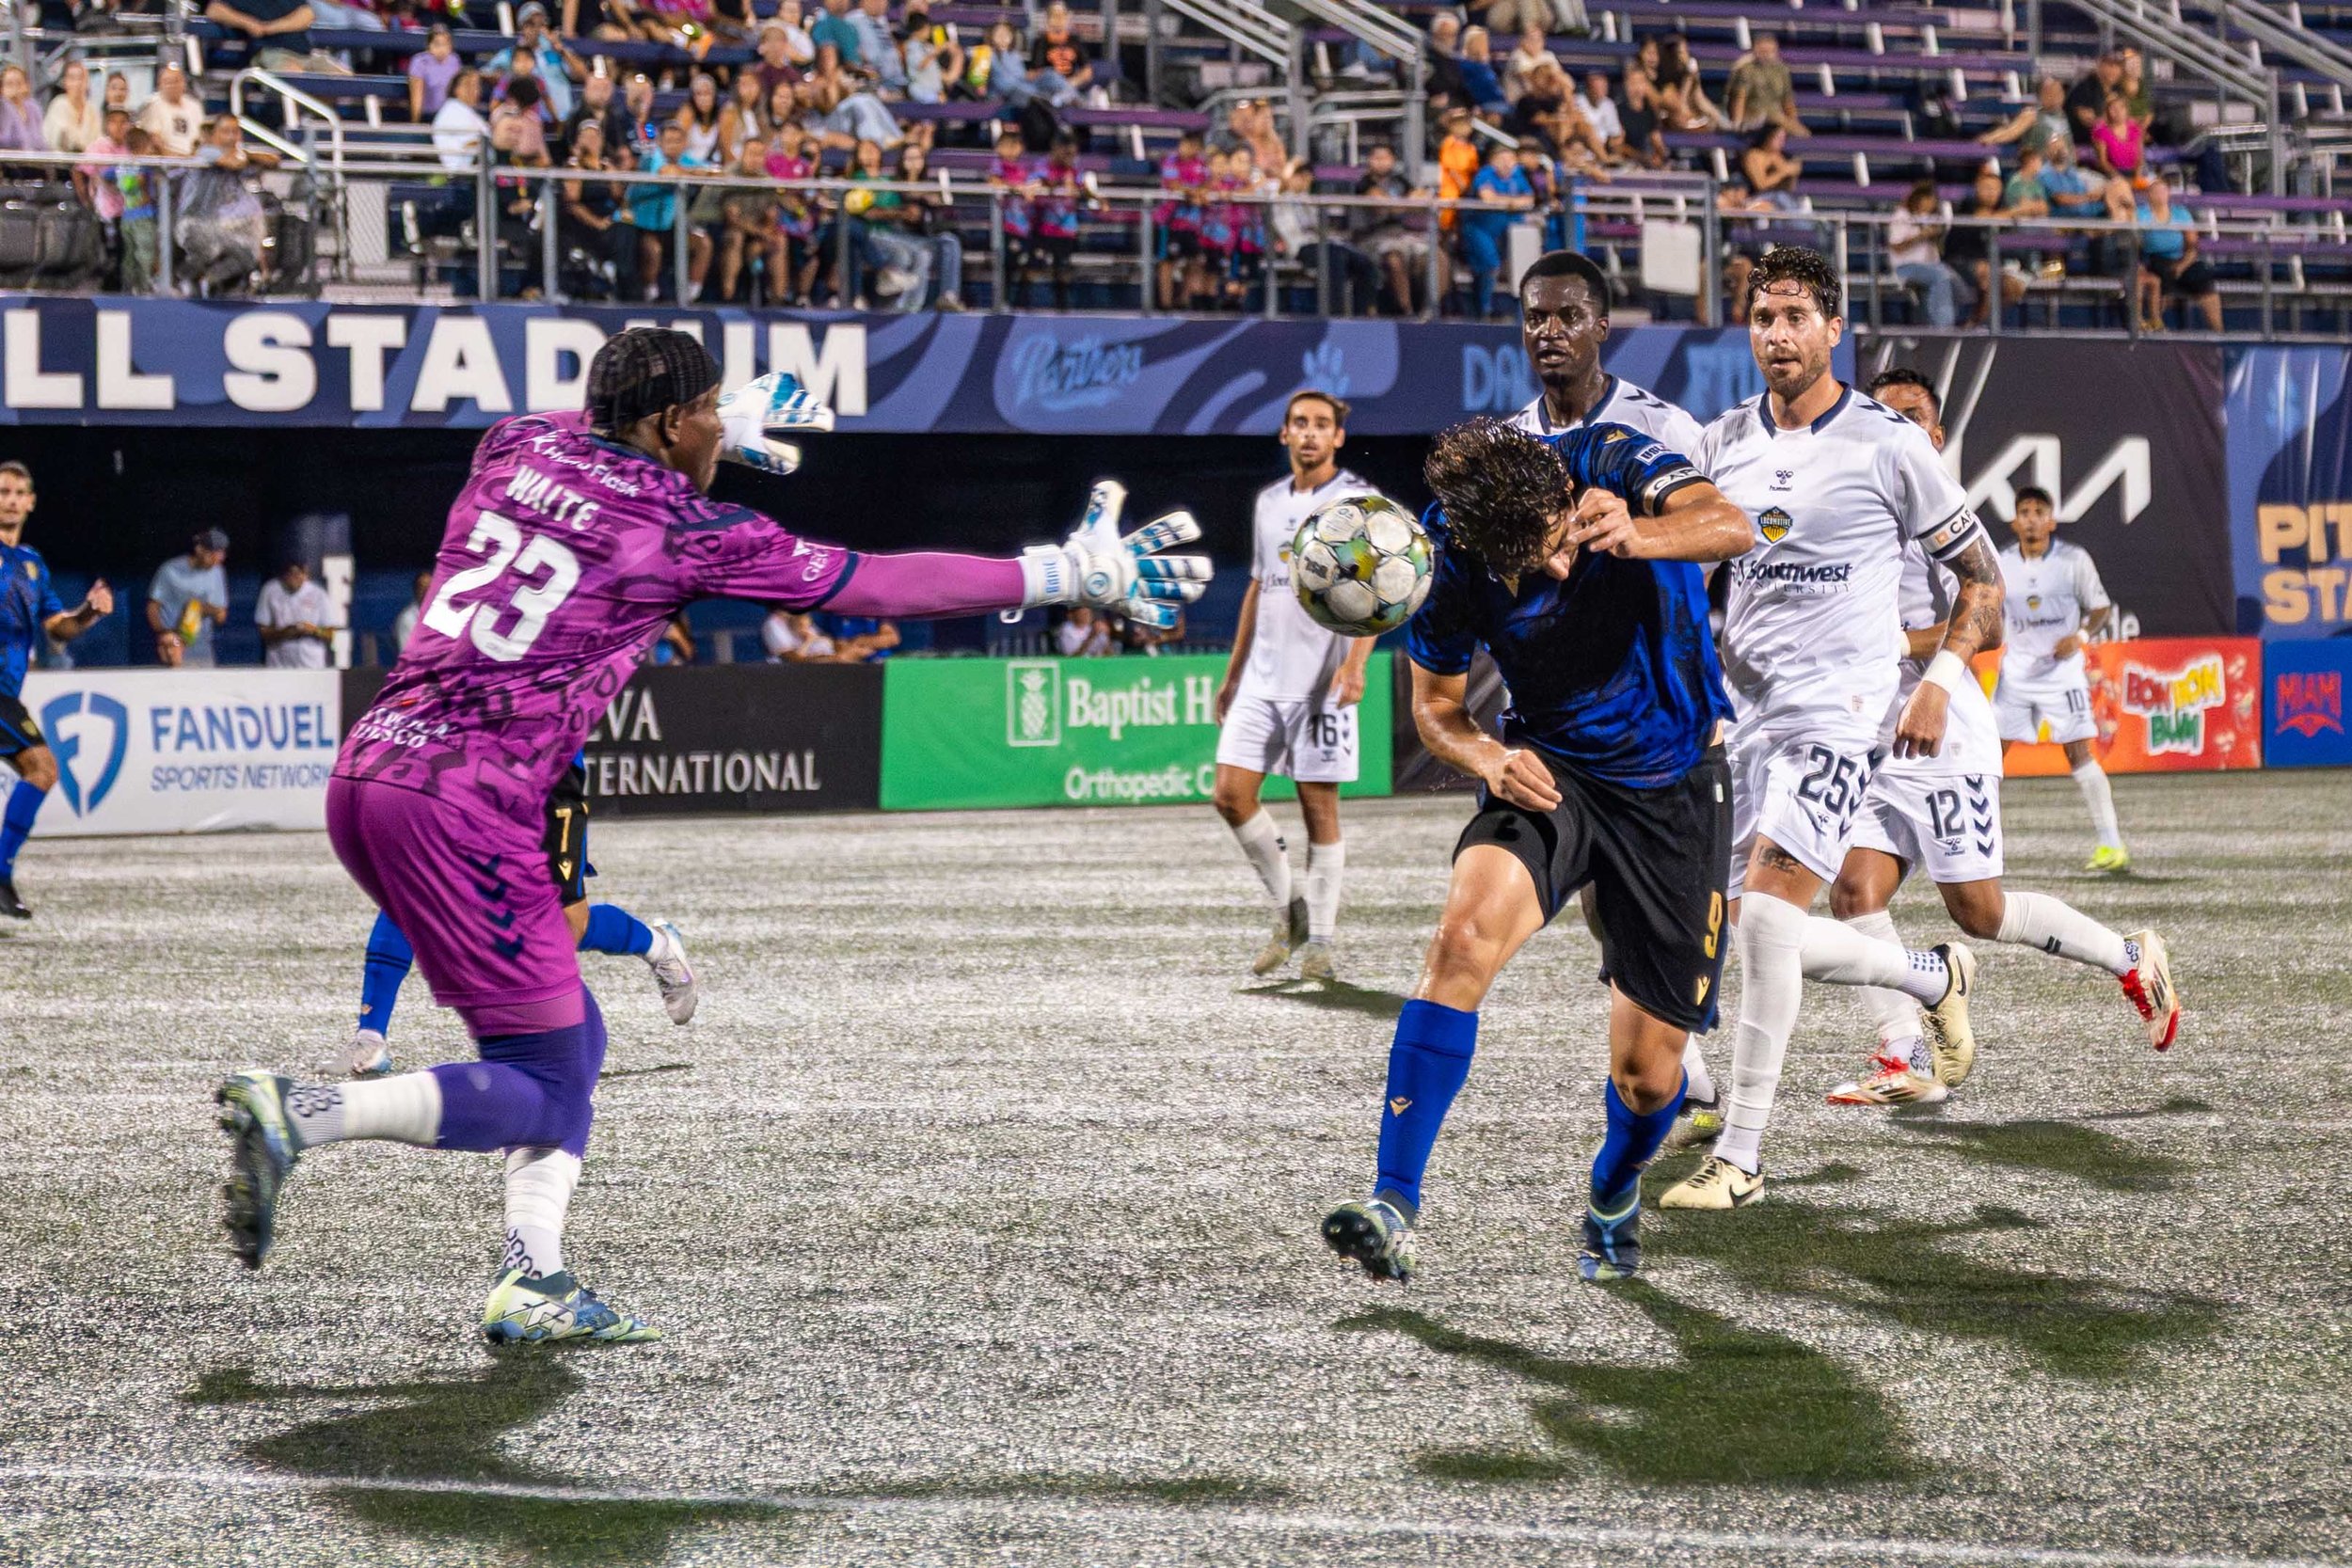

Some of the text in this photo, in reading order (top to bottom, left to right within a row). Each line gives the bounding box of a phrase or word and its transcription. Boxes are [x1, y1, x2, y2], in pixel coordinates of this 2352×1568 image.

[3, 309, 867, 417] LL STADM
[505, 465, 601, 531] WAITE
[2258, 503, 2352, 563] PIT
[422, 509, 581, 662] 23
[1746, 560, 1852, 583] Southwest
[2262, 569, 2352, 624] ST
[150, 704, 334, 752] FANDUEL
[585, 686, 662, 742] VA
[1067, 674, 1177, 740] Baptist
[2065, 689, 2086, 713] 10
[1311, 712, 1338, 748] 16
[151, 764, 237, 792] SPORTS
[1064, 765, 1193, 804] Orthopedic
[1798, 743, 1858, 816] 25
[555, 807, 572, 853] 7
[1925, 789, 1966, 839] 12
[1704, 890, 1724, 959] 9
